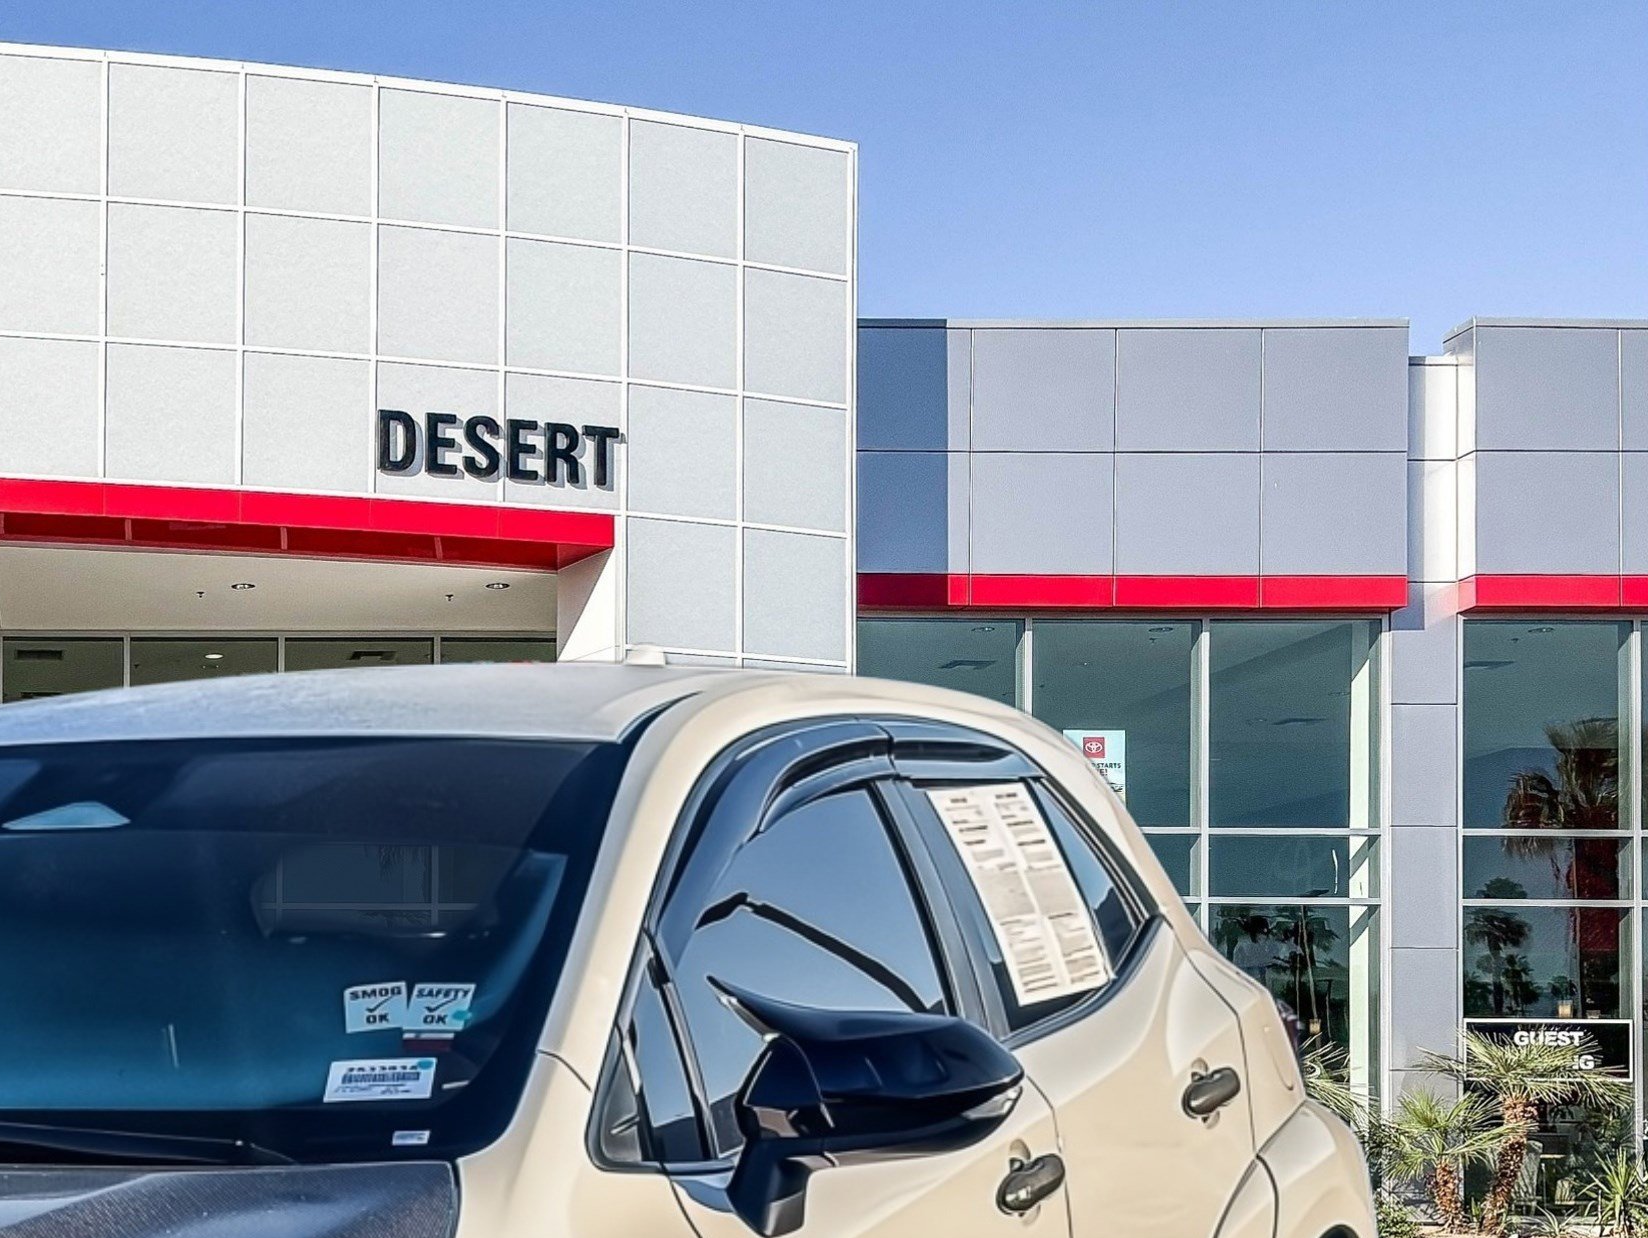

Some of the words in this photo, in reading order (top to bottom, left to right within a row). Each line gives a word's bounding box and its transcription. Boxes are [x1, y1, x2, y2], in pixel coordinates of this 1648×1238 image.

[377, 408, 621, 487] DESERT
[349, 986, 403, 1001] SMOG
[415, 988, 472, 999] SAFETY
[366, 1013, 389, 1025] OK
[423, 1014, 448, 1025] OK
[1513, 1030, 1585, 1047] GUEST
